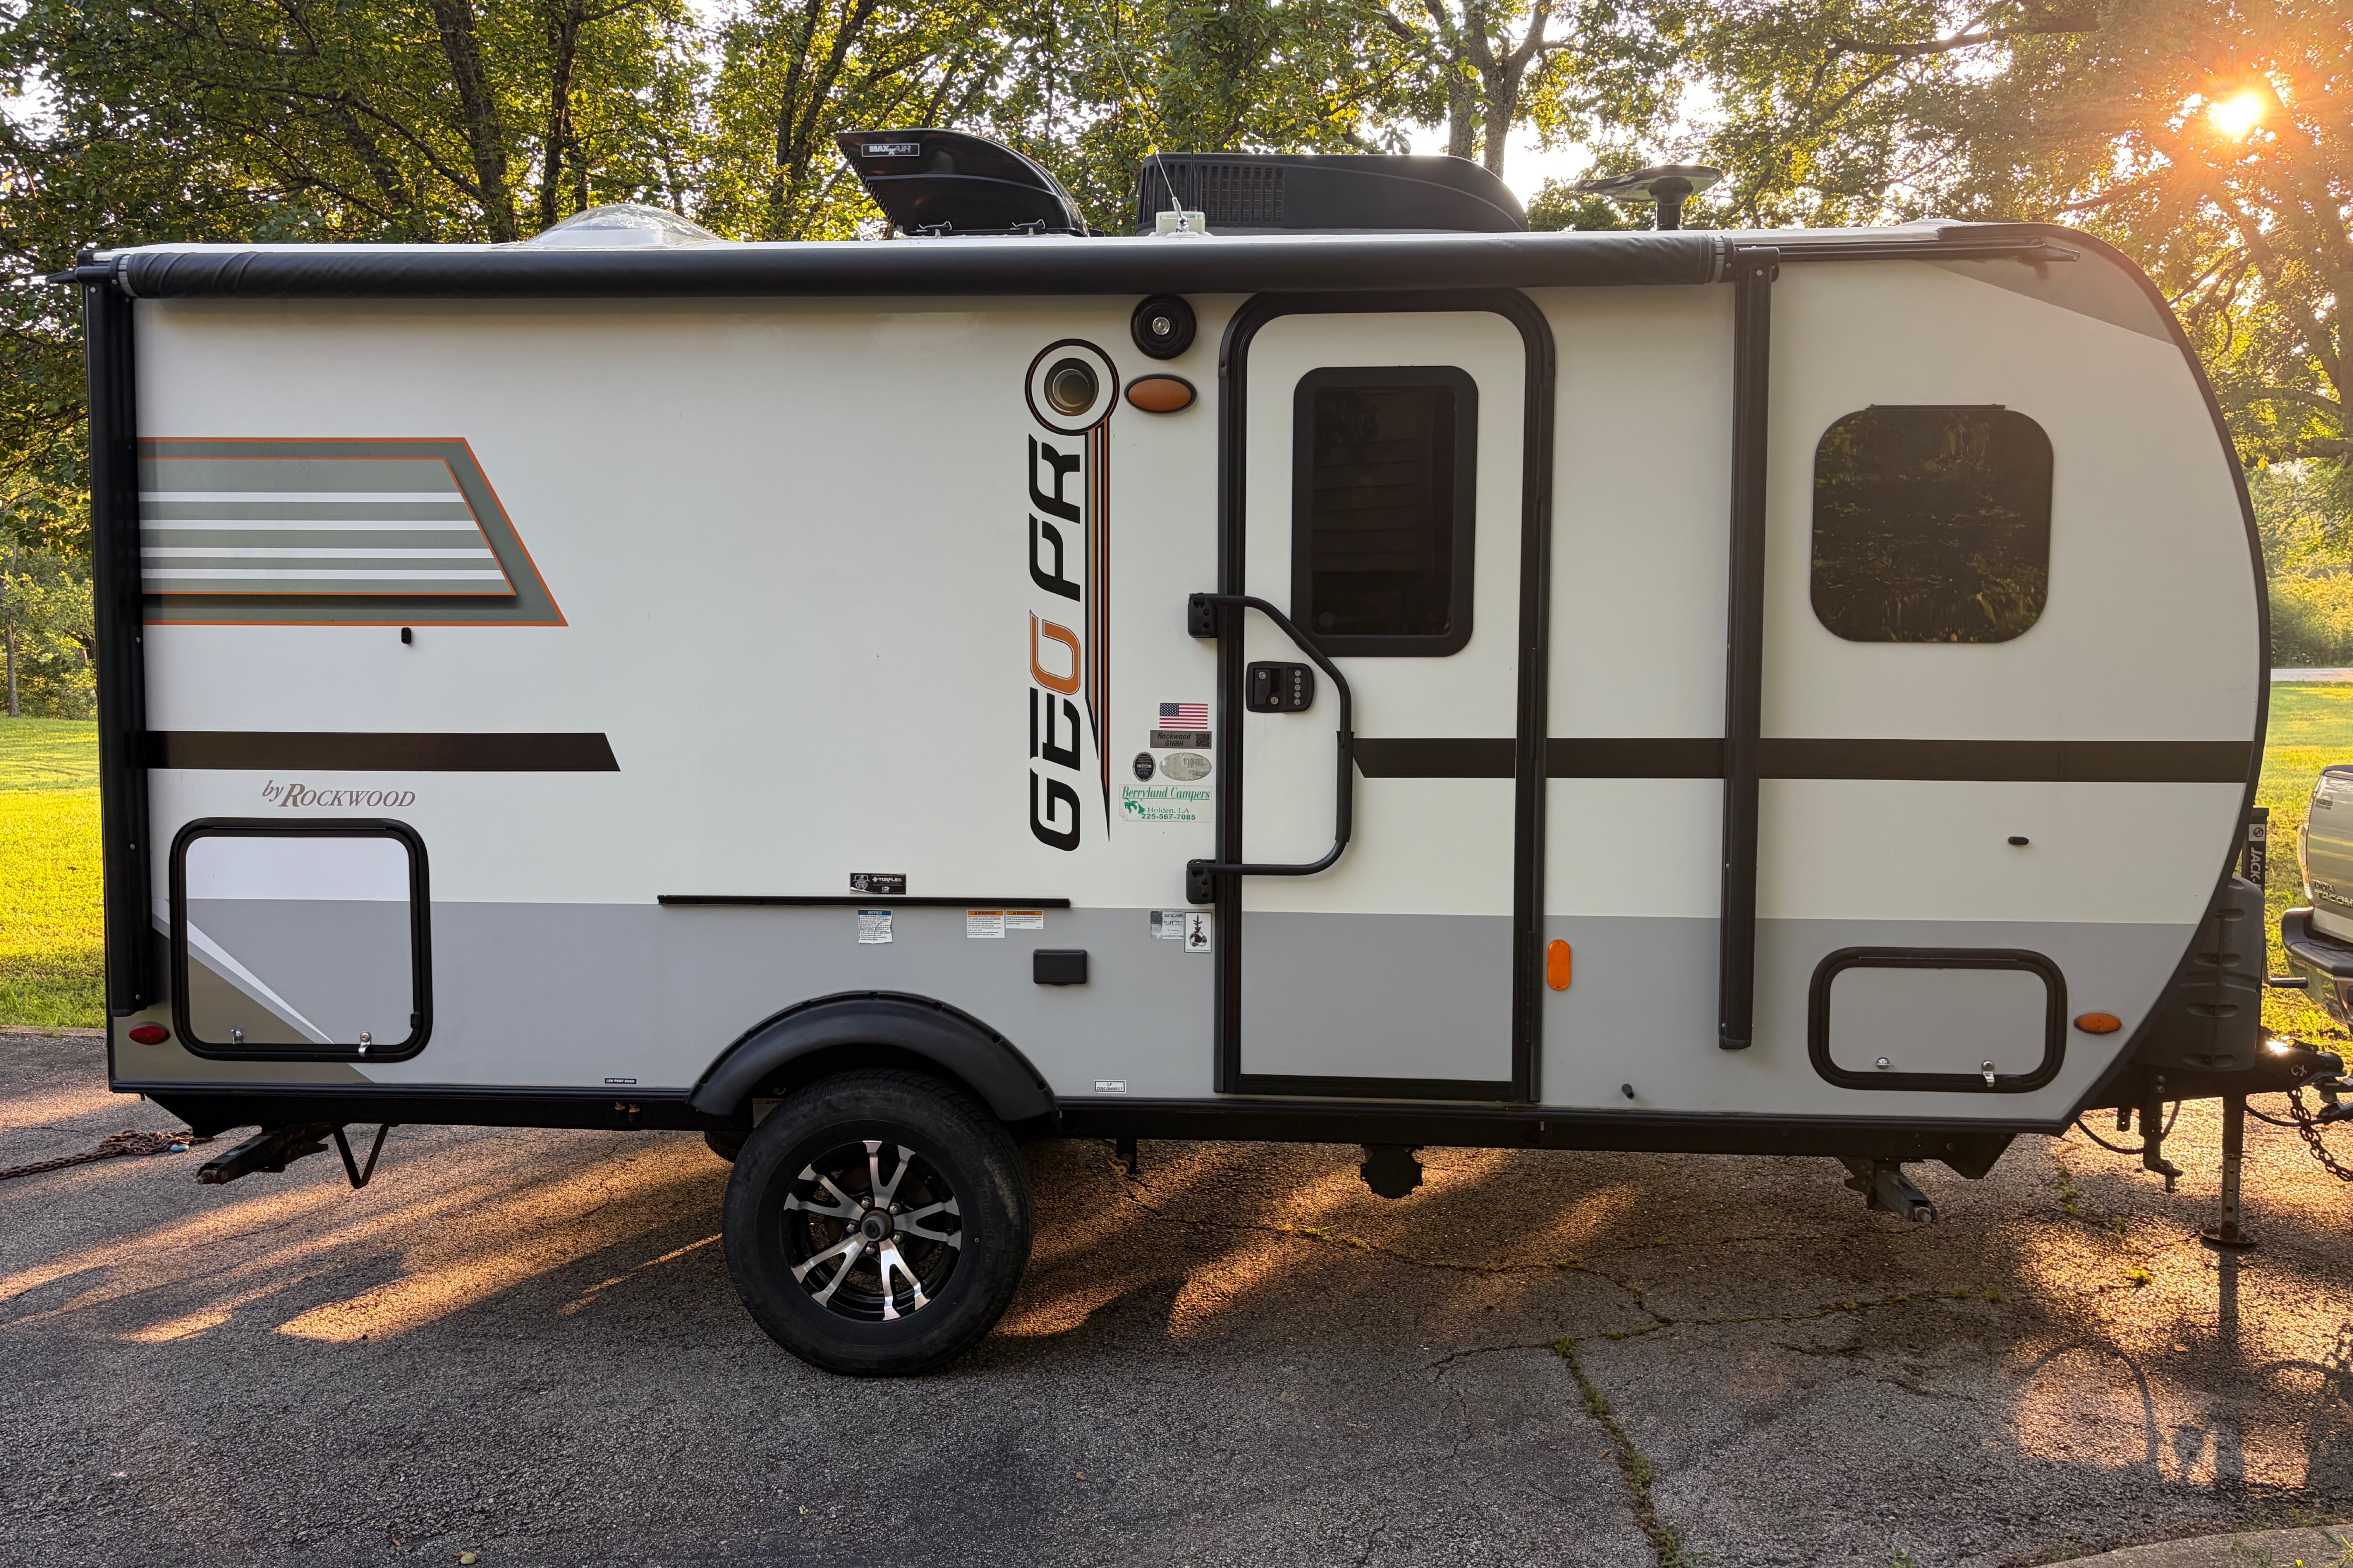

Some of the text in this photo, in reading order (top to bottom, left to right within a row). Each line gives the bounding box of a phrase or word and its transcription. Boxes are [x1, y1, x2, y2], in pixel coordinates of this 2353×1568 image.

[1029, 608, 1081, 851] GEO
[262, 780, 284, 802] by
[1122, 786, 1211, 802] Berryland Campers
